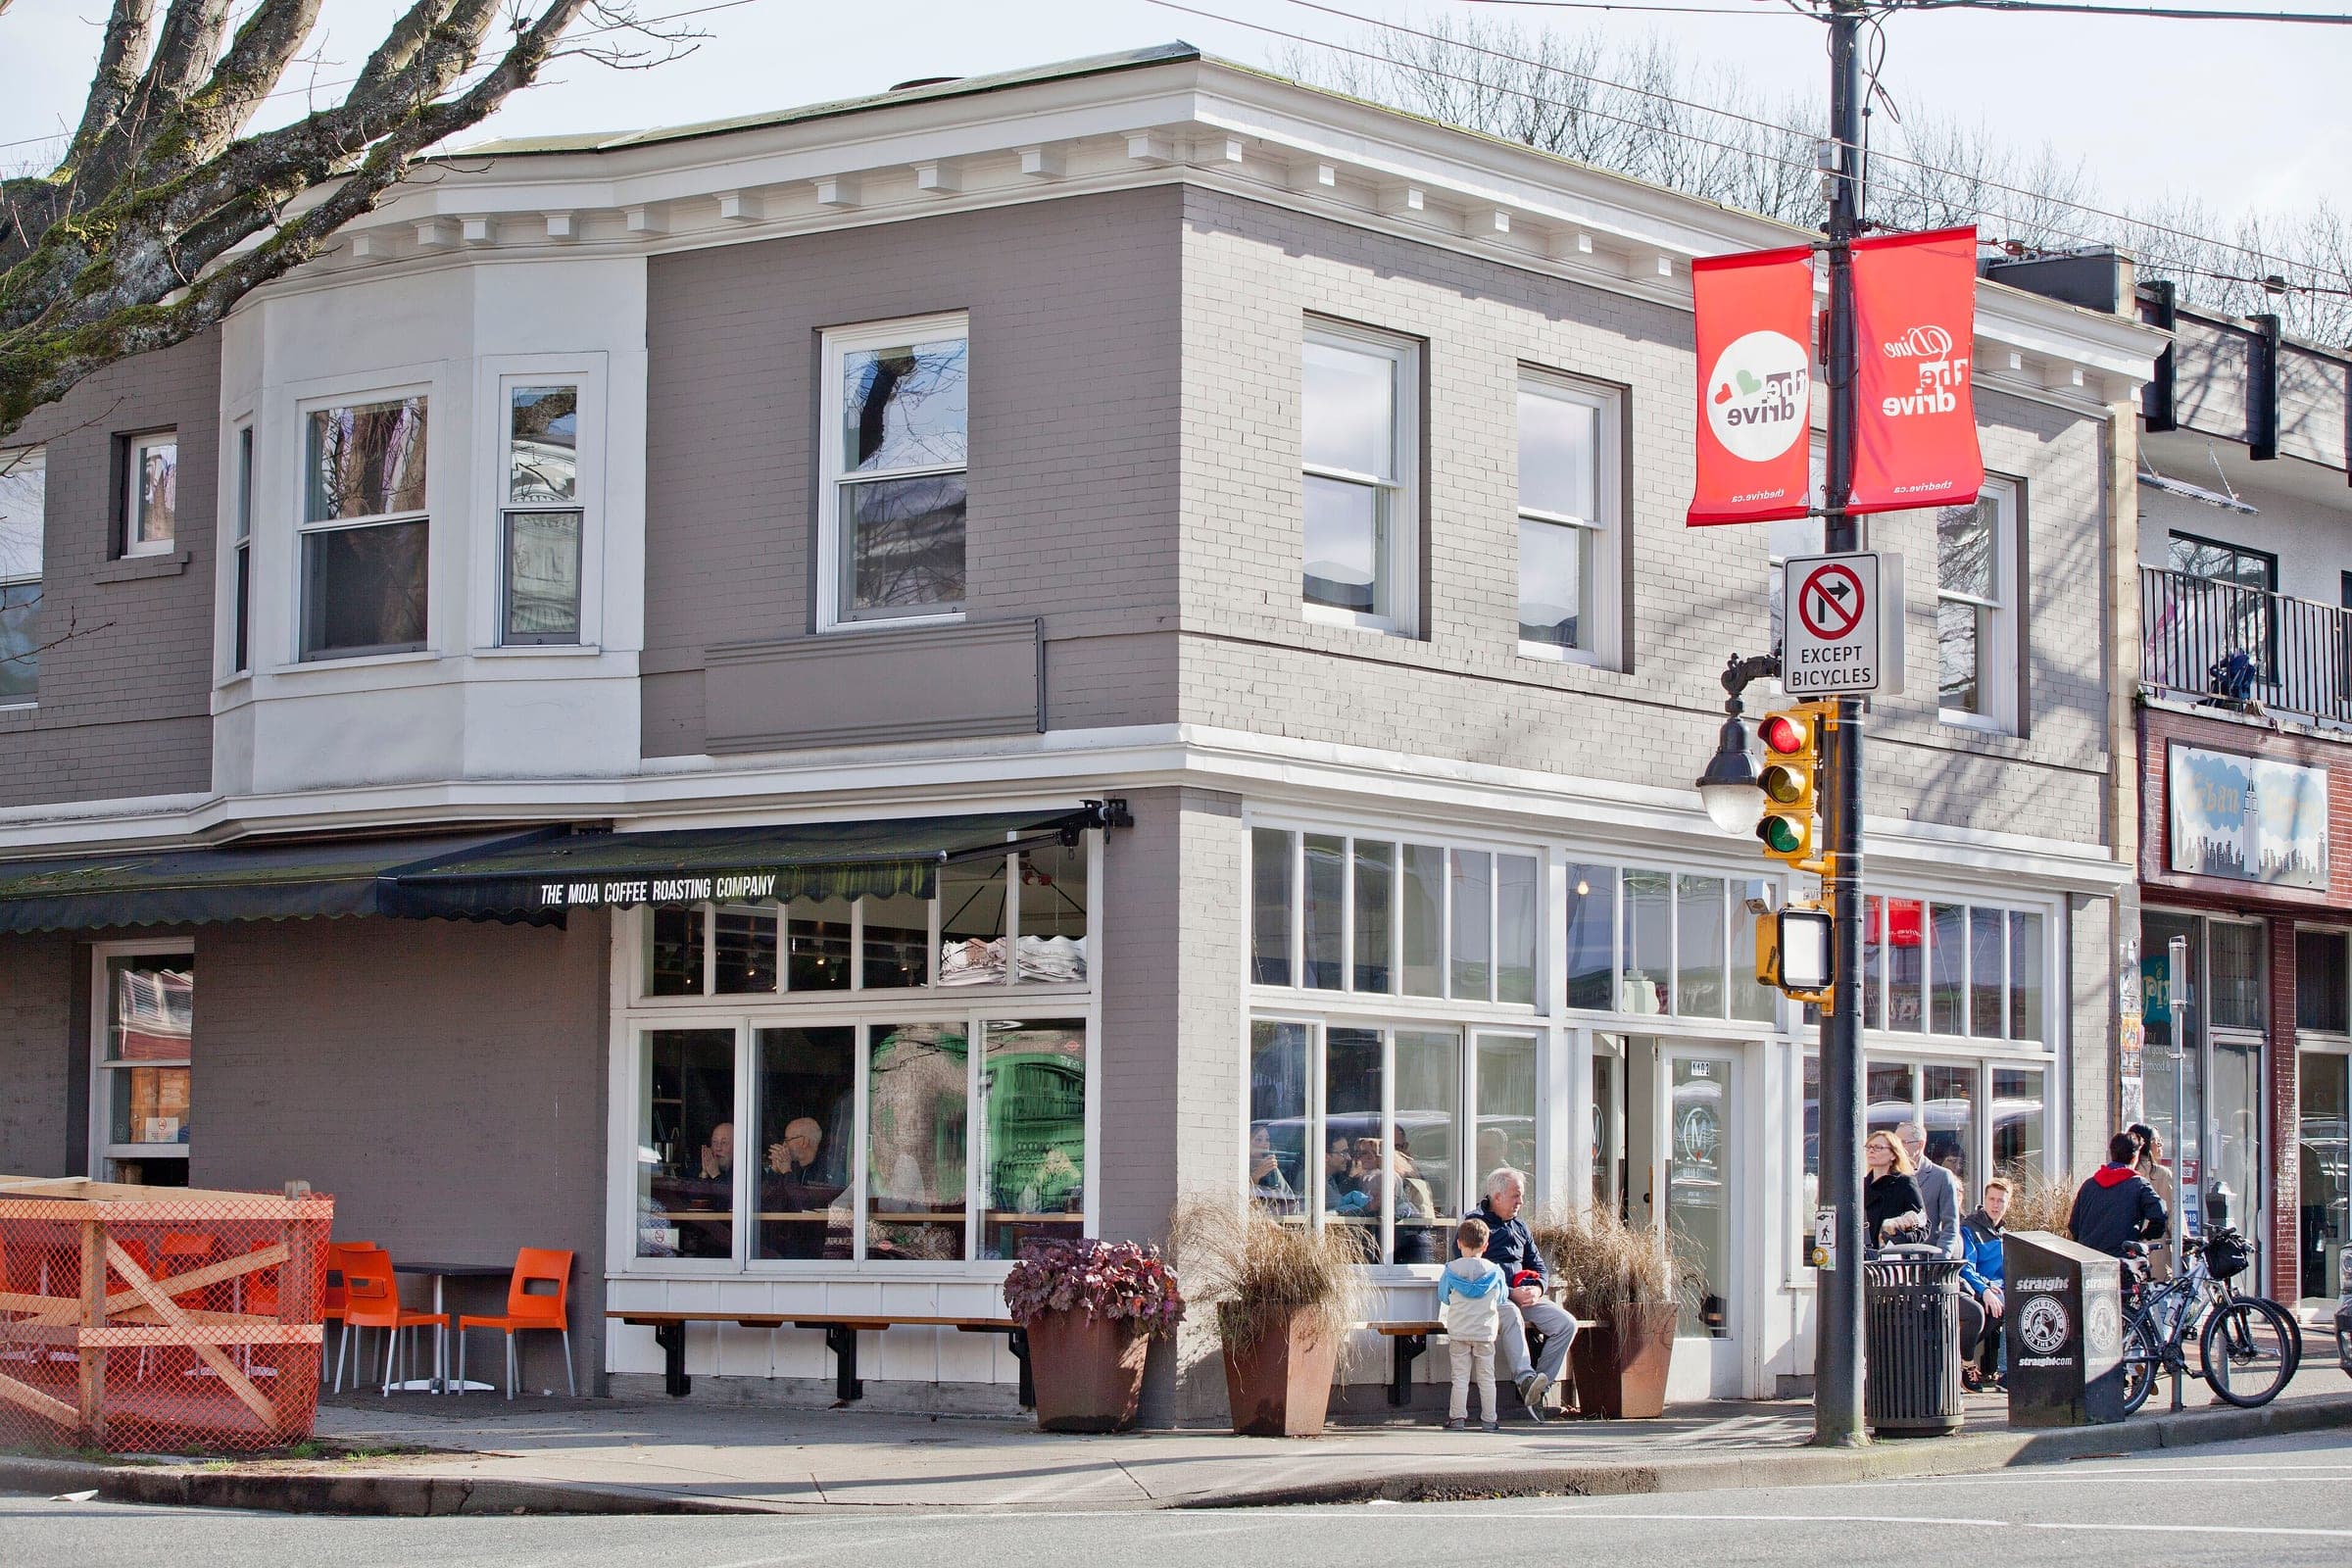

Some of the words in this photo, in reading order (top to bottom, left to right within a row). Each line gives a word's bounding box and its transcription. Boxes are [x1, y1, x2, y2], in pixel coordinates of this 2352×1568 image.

[1801, 645, 1863, 664] EXCEPT
[1791, 667, 1872, 687] BICYCLES
[541, 884, 564, 905] THE
[567, 883, 599, 904] MOJA
[604, 881, 648, 903] COFFEE
[652, 878, 711, 901] ROASTING
[716, 874, 776, 898] COMPANY
[2015, 1276, 2070, 1292] straight
